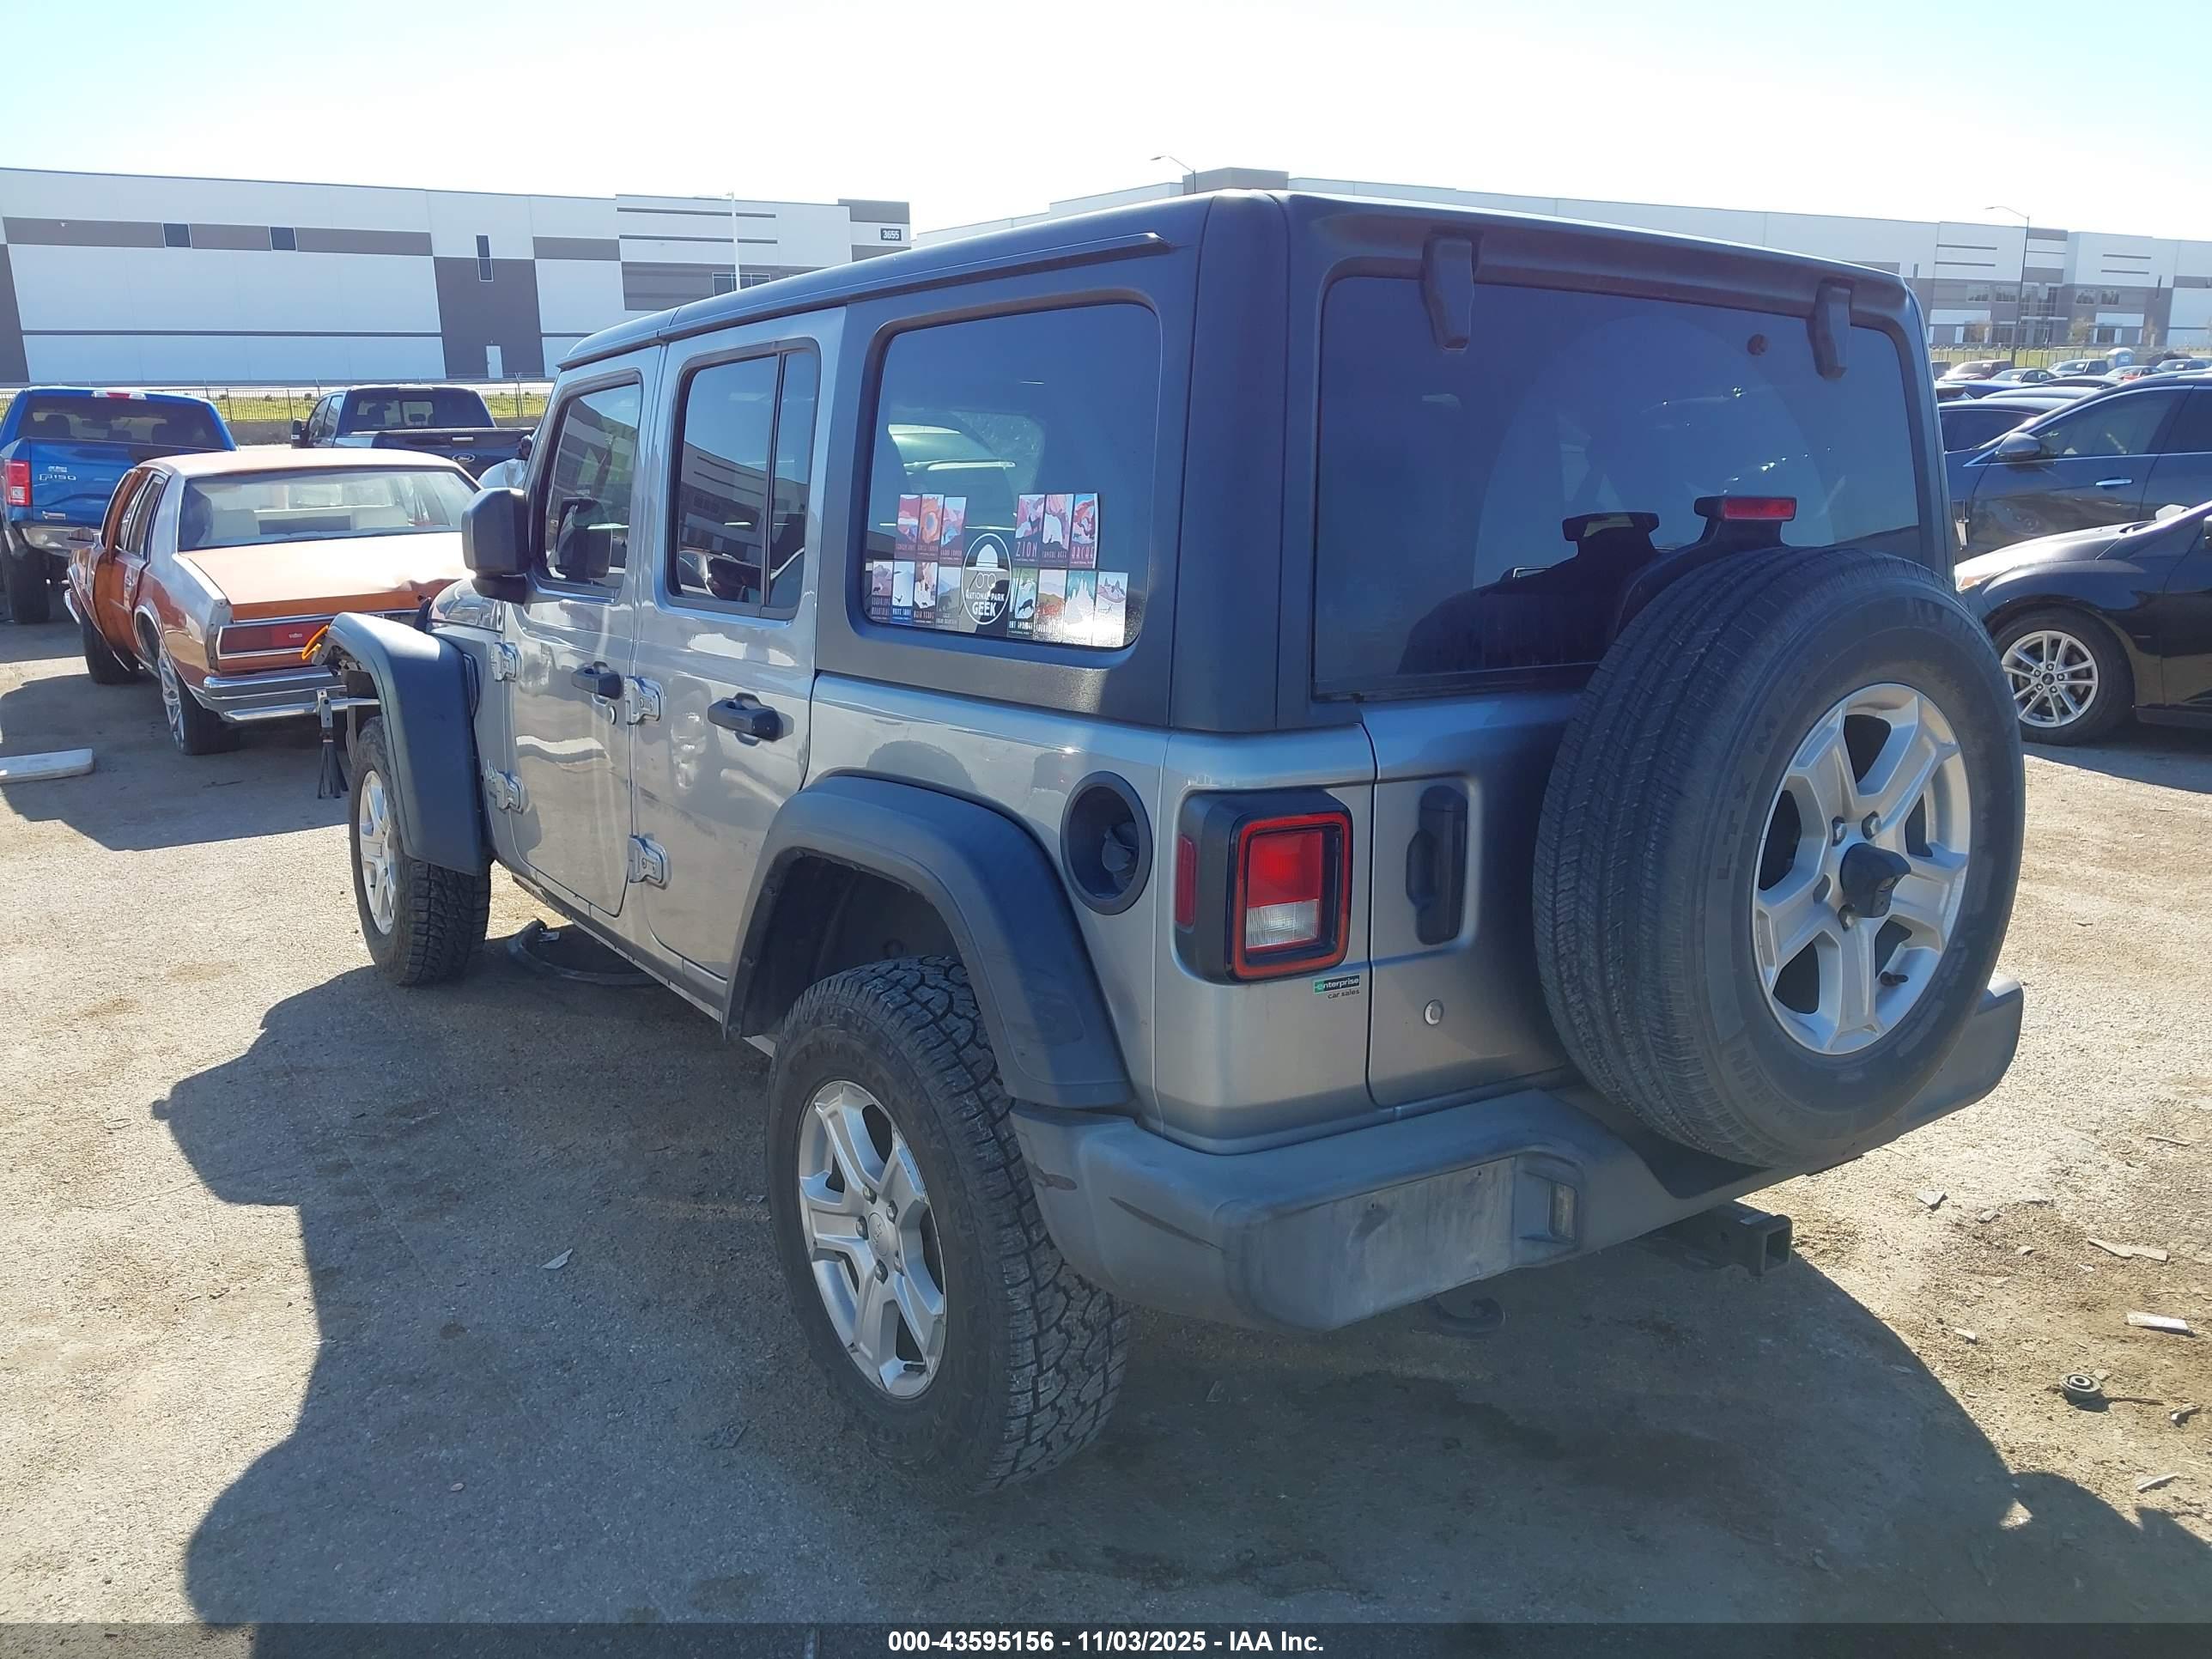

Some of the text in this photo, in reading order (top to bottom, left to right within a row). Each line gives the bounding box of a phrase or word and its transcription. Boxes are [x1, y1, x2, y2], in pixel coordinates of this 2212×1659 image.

[883, 230, 899, 240] 3655
[1016, 541, 1038, 557] ZION
[965, 592, 1005, 601] NATIONAL PARK
[972, 601, 997, 617] GEEK
[1316, 977, 1359, 990] enterprise
